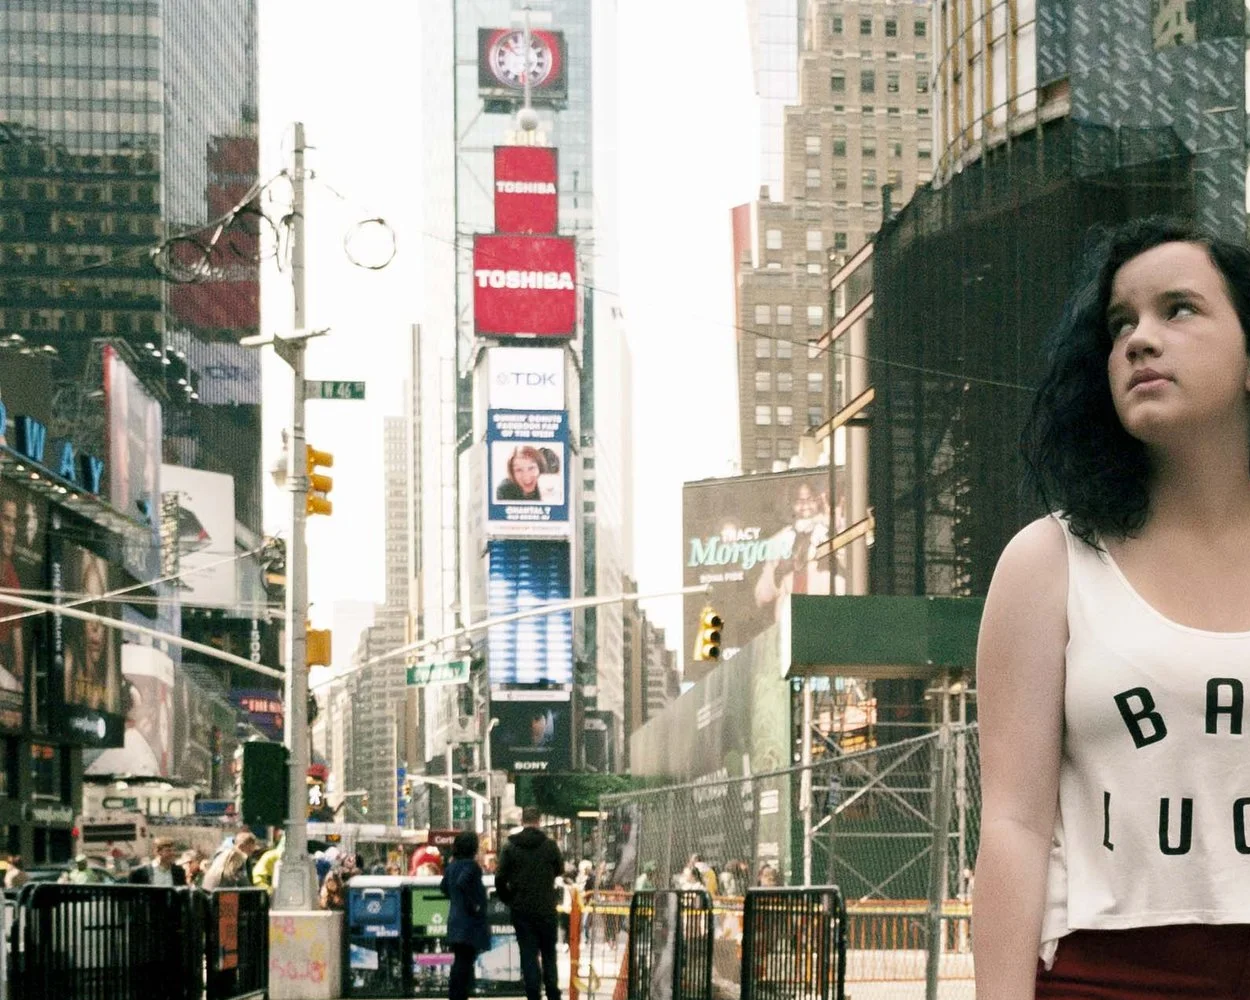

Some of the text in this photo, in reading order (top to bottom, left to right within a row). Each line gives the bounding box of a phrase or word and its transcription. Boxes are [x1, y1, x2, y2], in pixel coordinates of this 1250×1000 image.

[496, 181, 556, 194] TOSHIBA
[475, 269, 574, 290] TOSHIBA
[511, 372, 556, 386] TDK
[688, 537, 793, 569] Morgan
[514, 761, 548, 770] SONY
